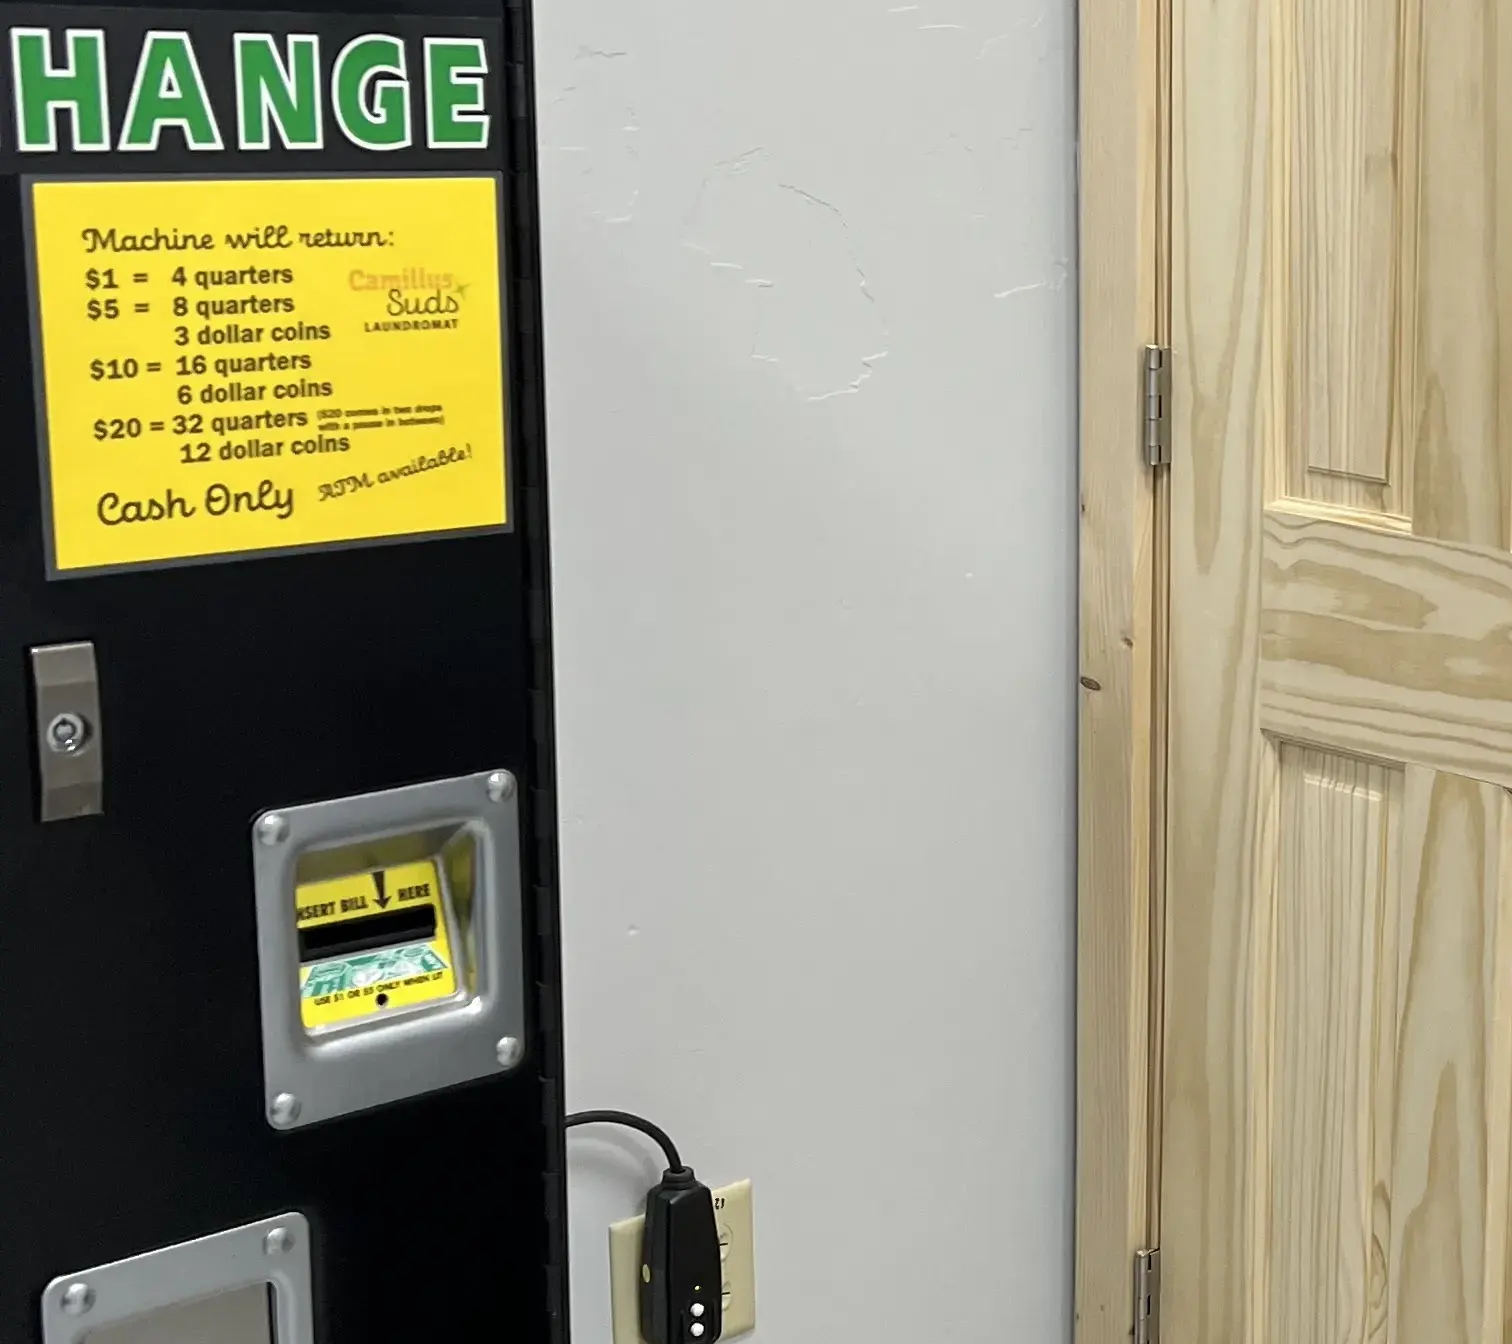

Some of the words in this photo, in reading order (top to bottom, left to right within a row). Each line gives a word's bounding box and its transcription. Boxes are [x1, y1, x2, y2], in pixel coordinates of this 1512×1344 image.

[9, 27, 490, 152] HANGE
[81, 227, 215, 253] Machine
[225, 225, 293, 249] will
[298, 229, 394, 248] return:
[85, 268, 119, 290] $1
[172, 266, 187, 286] 4
[195, 266, 294, 290] quarters
[349, 267, 453, 292] Camillus
[87, 297, 119, 320] $5
[173, 297, 188, 317] 8
[196, 295, 295, 320] quarters
[386, 288, 459, 316] Suds
[174, 326, 189, 346] 3
[197, 324, 264, 345] dollar
[271, 321, 331, 341] coins
[364, 319, 459, 332] LAUNDROMAT
[90, 358, 138, 381] $10
[176, 355, 207, 376] 16
[214, 352, 312, 377] quarters
[177, 385, 192, 405] 6
[200, 382, 266, 404] dollar
[273, 378, 333, 399] coins
[93, 418, 141, 441] $20
[172, 414, 203, 435] 32
[211, 410, 308, 436] quarters
[180, 442, 211, 463] 12
[219, 439, 284, 460] dollar
[290, 434, 350, 455] coins
[318, 473, 374, 501] ATM
[377, 443, 473, 484] available!
[97, 488, 196, 525] Cash
[205, 479, 293, 519] Only
[340, 896, 369, 913] BILL
[398, 884, 430, 902] HERE
